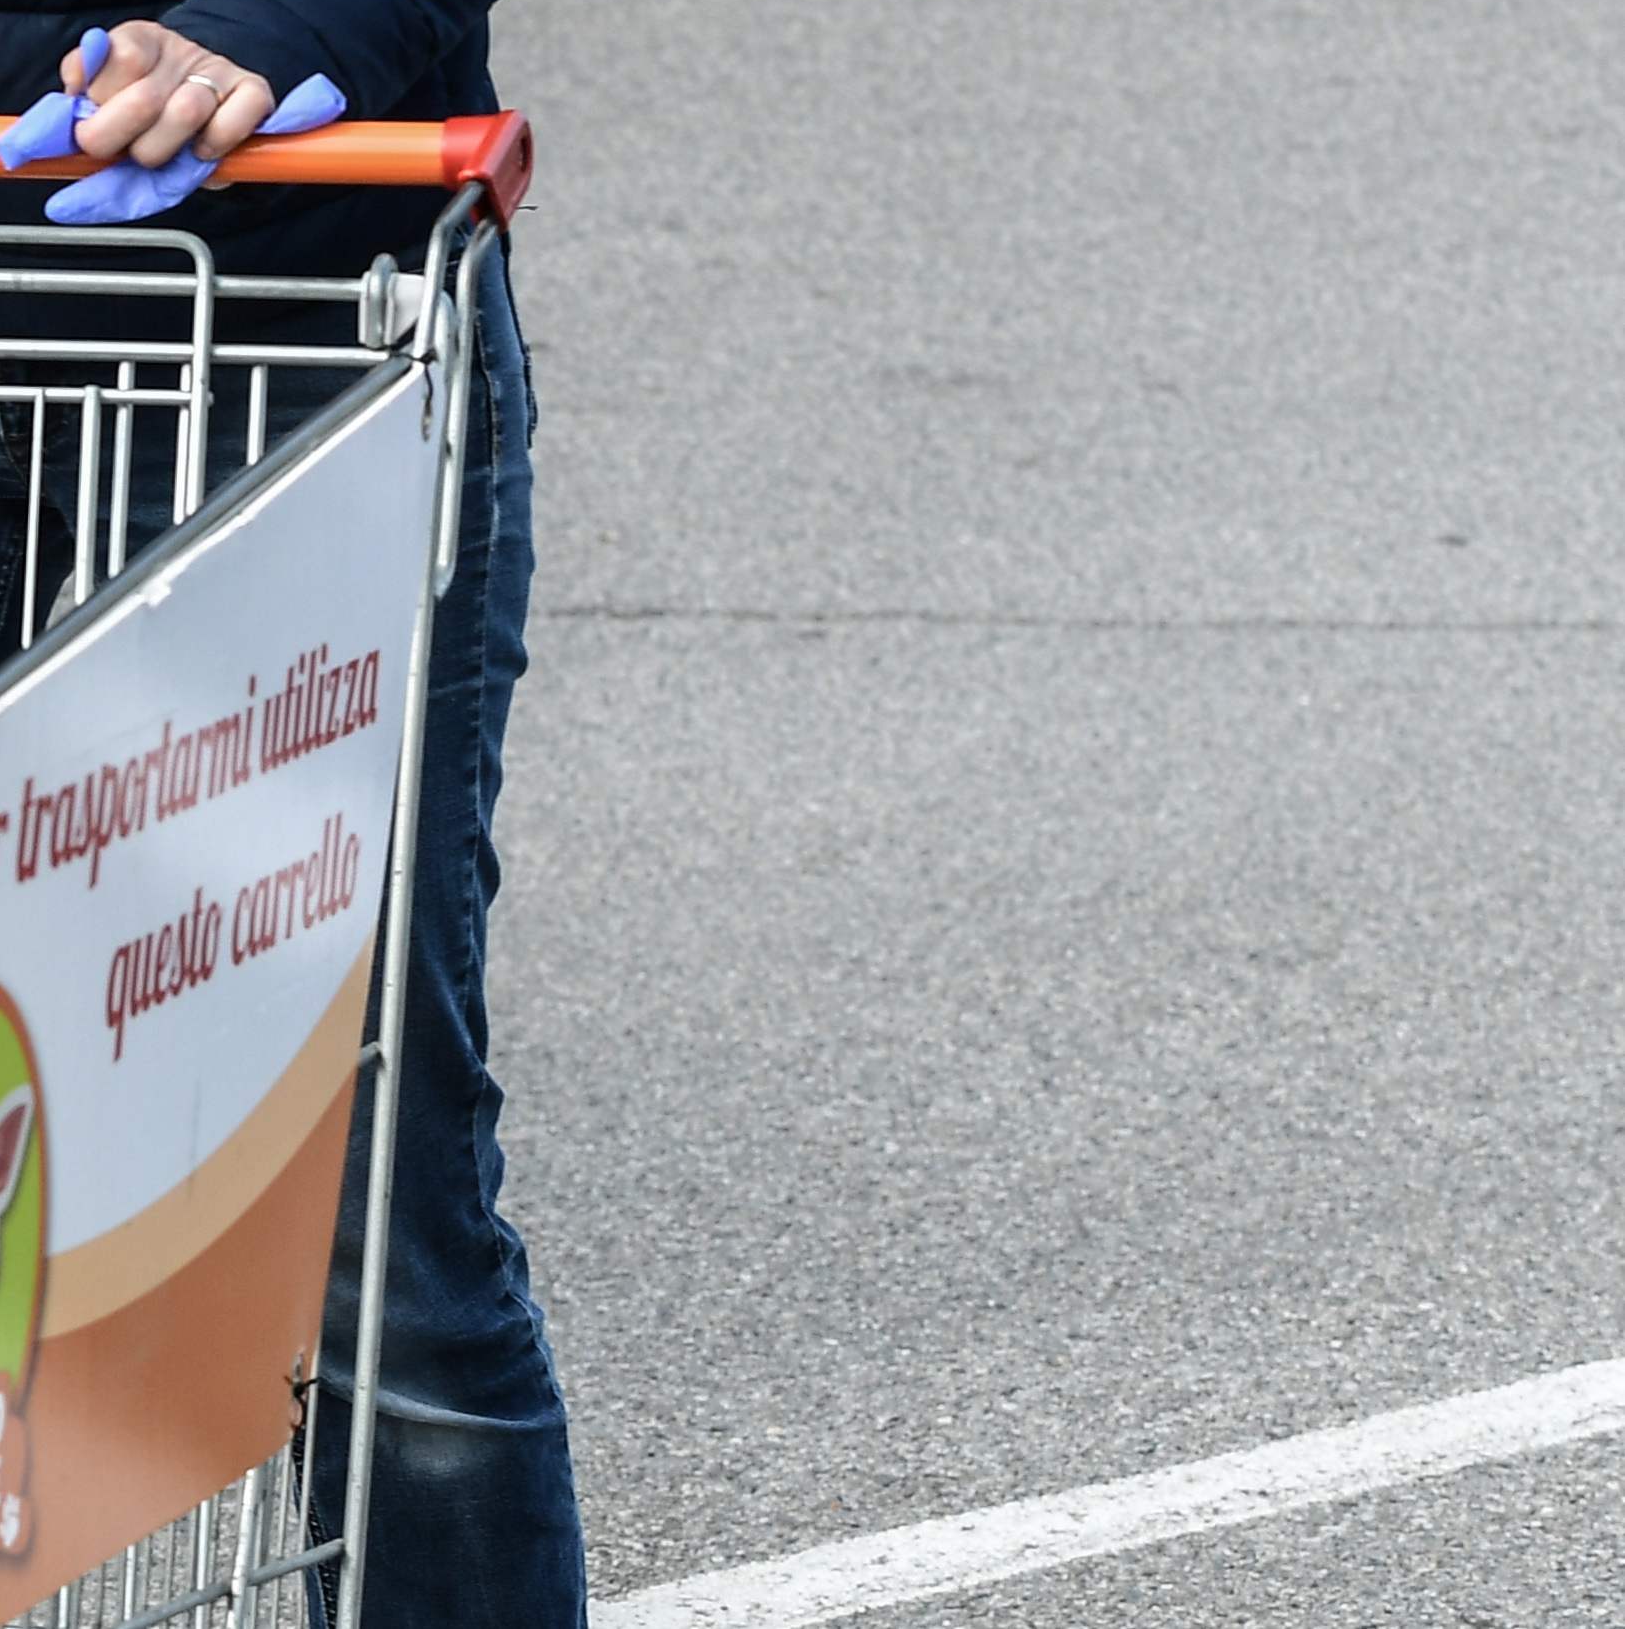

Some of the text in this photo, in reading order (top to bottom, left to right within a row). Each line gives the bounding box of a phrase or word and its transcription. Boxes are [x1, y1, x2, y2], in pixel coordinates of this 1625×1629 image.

[15, 674, 257, 889] trasportarmi
[259, 642, 381, 774] utilizza
[105, 811, 362, 1063] questo carrello
